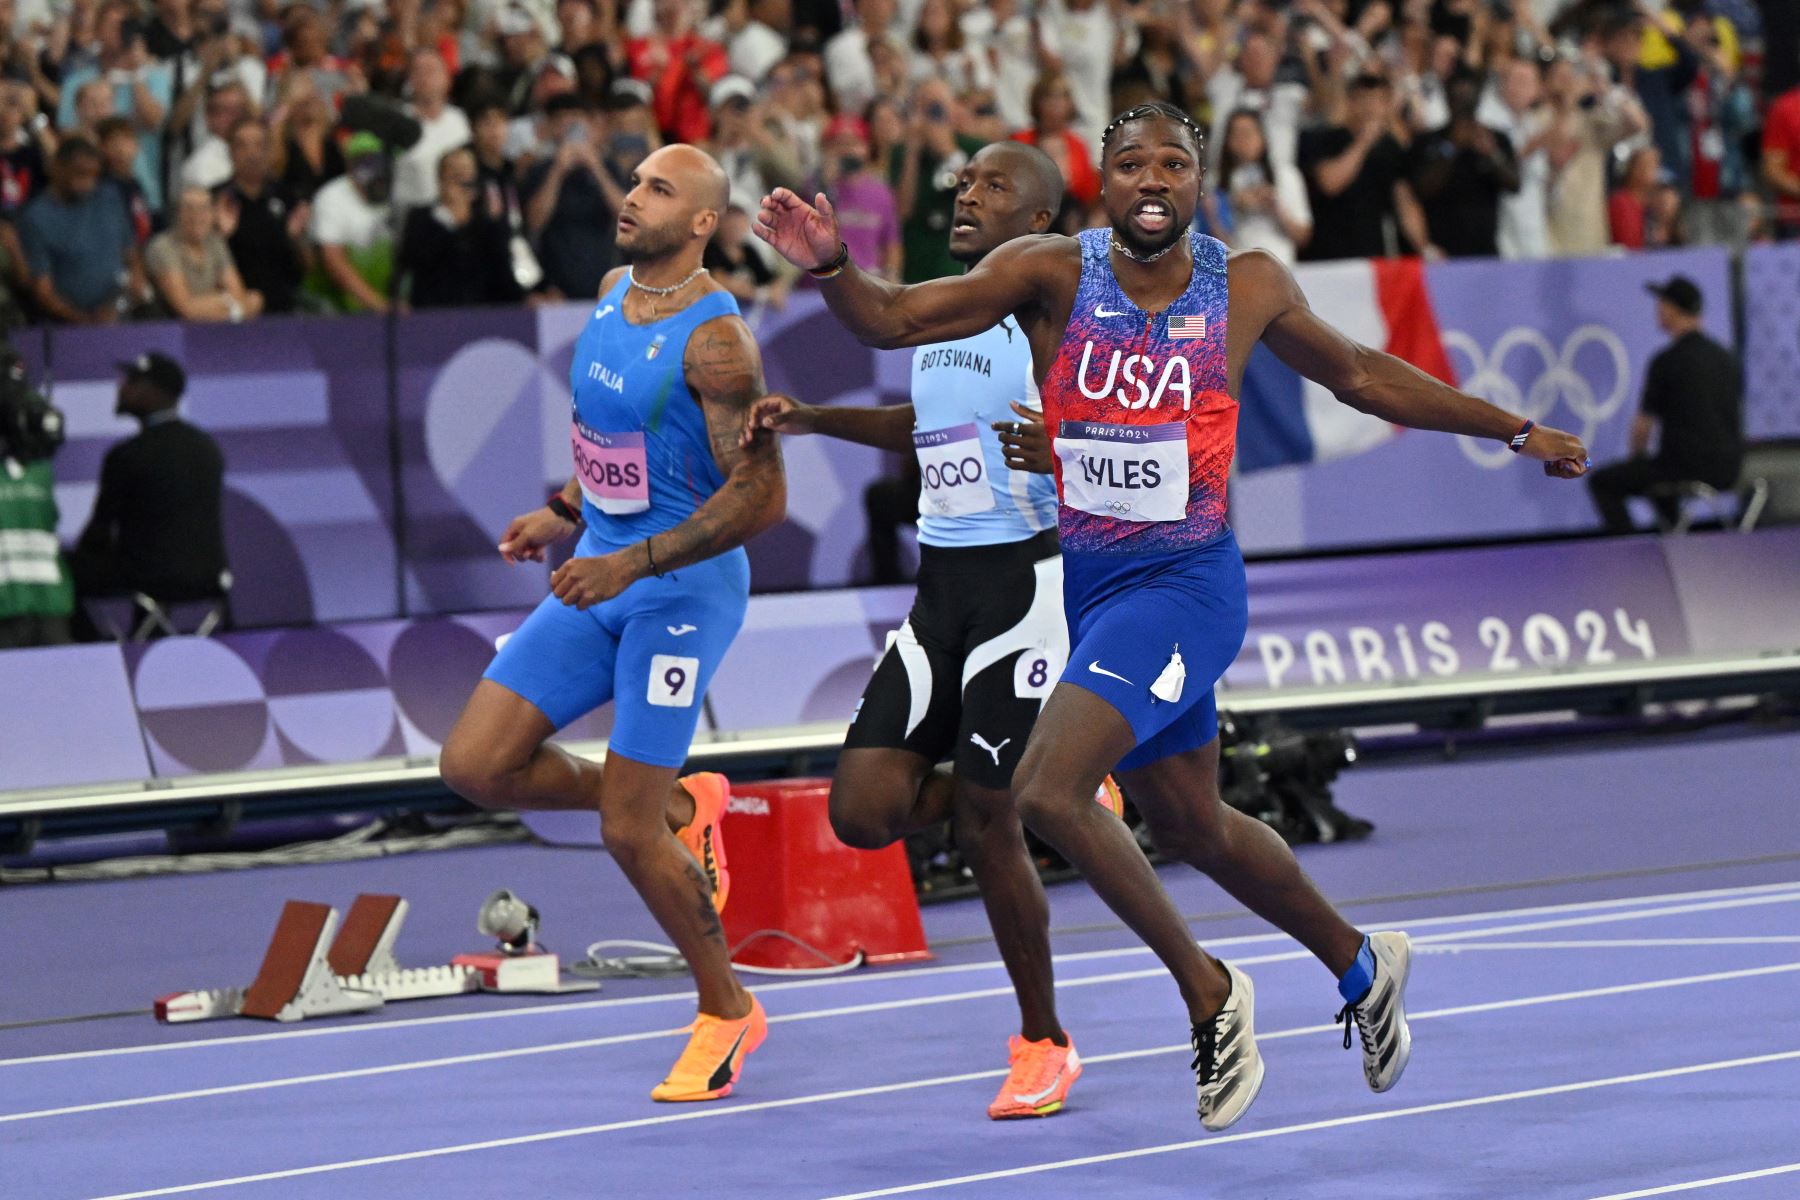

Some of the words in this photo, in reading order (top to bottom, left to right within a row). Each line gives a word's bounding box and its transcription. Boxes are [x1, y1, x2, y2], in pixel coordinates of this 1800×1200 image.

[588, 361, 624, 394] ITALIA
[921, 349, 991, 377] BOTSWANA
[1077, 340, 1192, 411] USA
[1085, 426, 1116, 437] PARIS
[1119, 428, 1149, 439] 2024
[1080, 454, 1161, 489] LYLES
[1478, 607, 1656, 674] 2024
[664, 667, 686, 696] 9
[1027, 658, 1048, 688] 8
